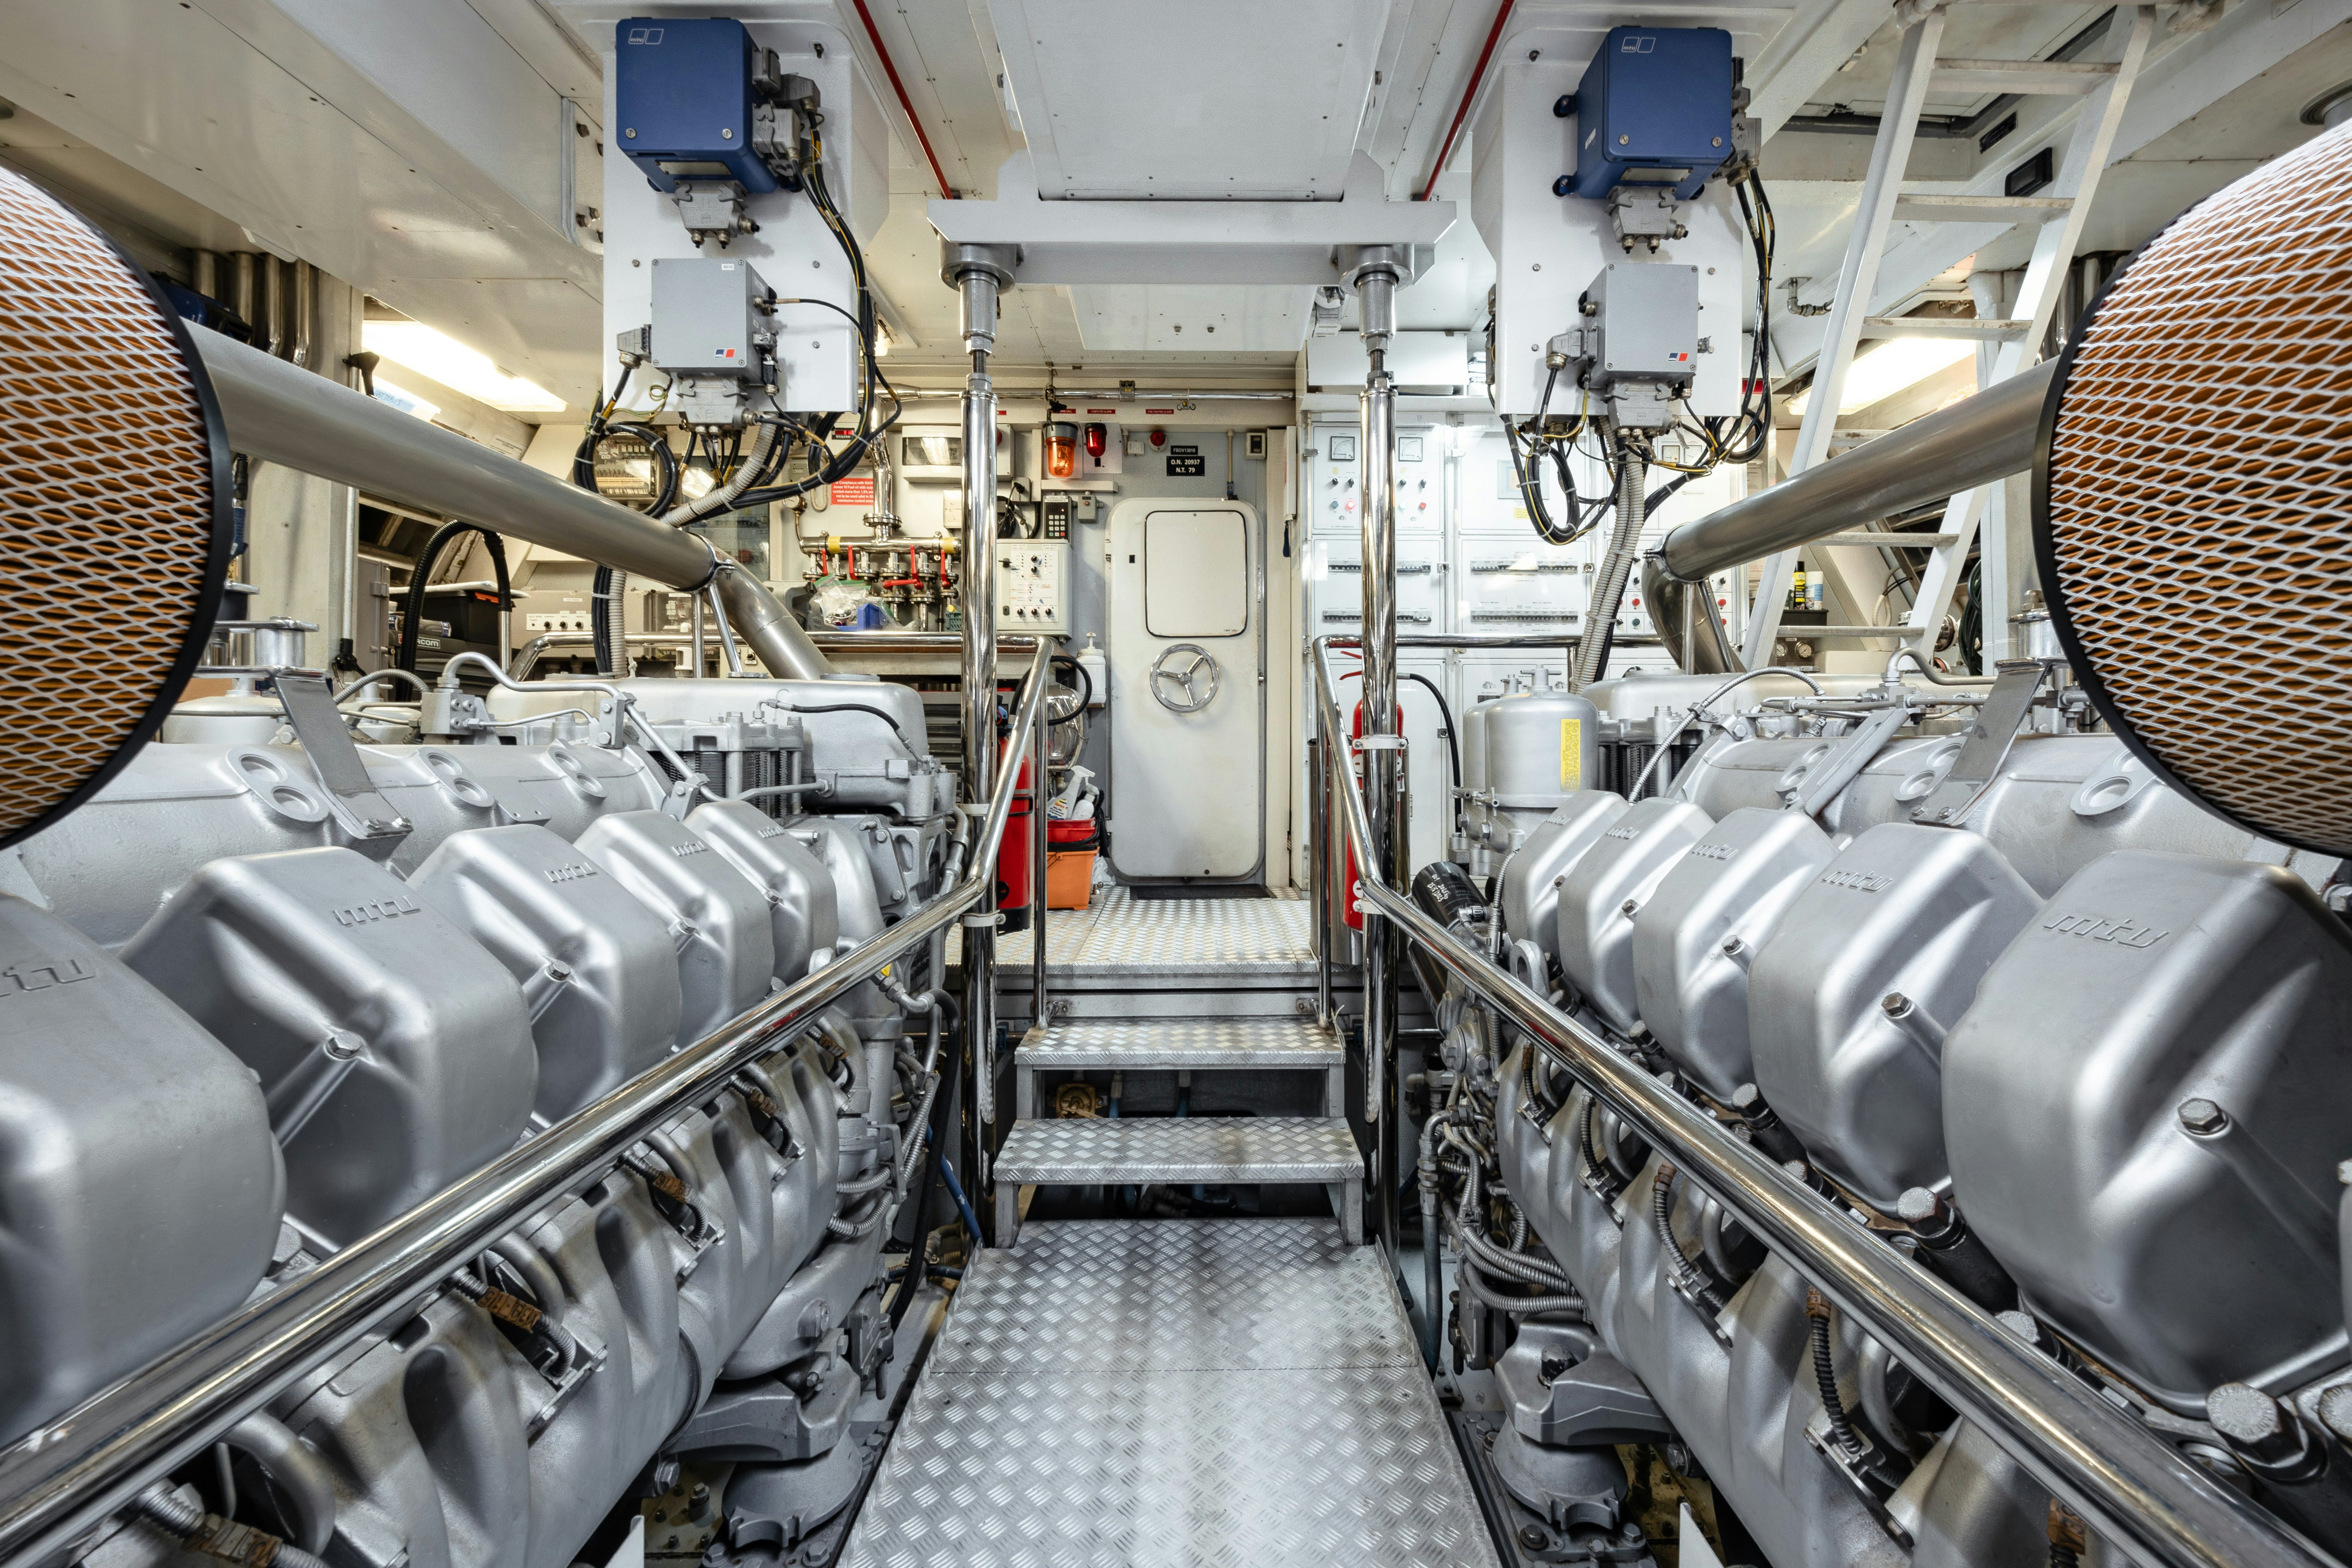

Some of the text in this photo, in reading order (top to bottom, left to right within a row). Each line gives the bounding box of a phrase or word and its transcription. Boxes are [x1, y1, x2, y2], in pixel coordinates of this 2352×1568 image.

[1692, 844, 1738, 860] mtu
[544, 862, 597, 883] mtu
[1822, 871, 1892, 892] mtu
[332, 896, 421, 925] mtu
[2043, 915, 2169, 949] mtu
